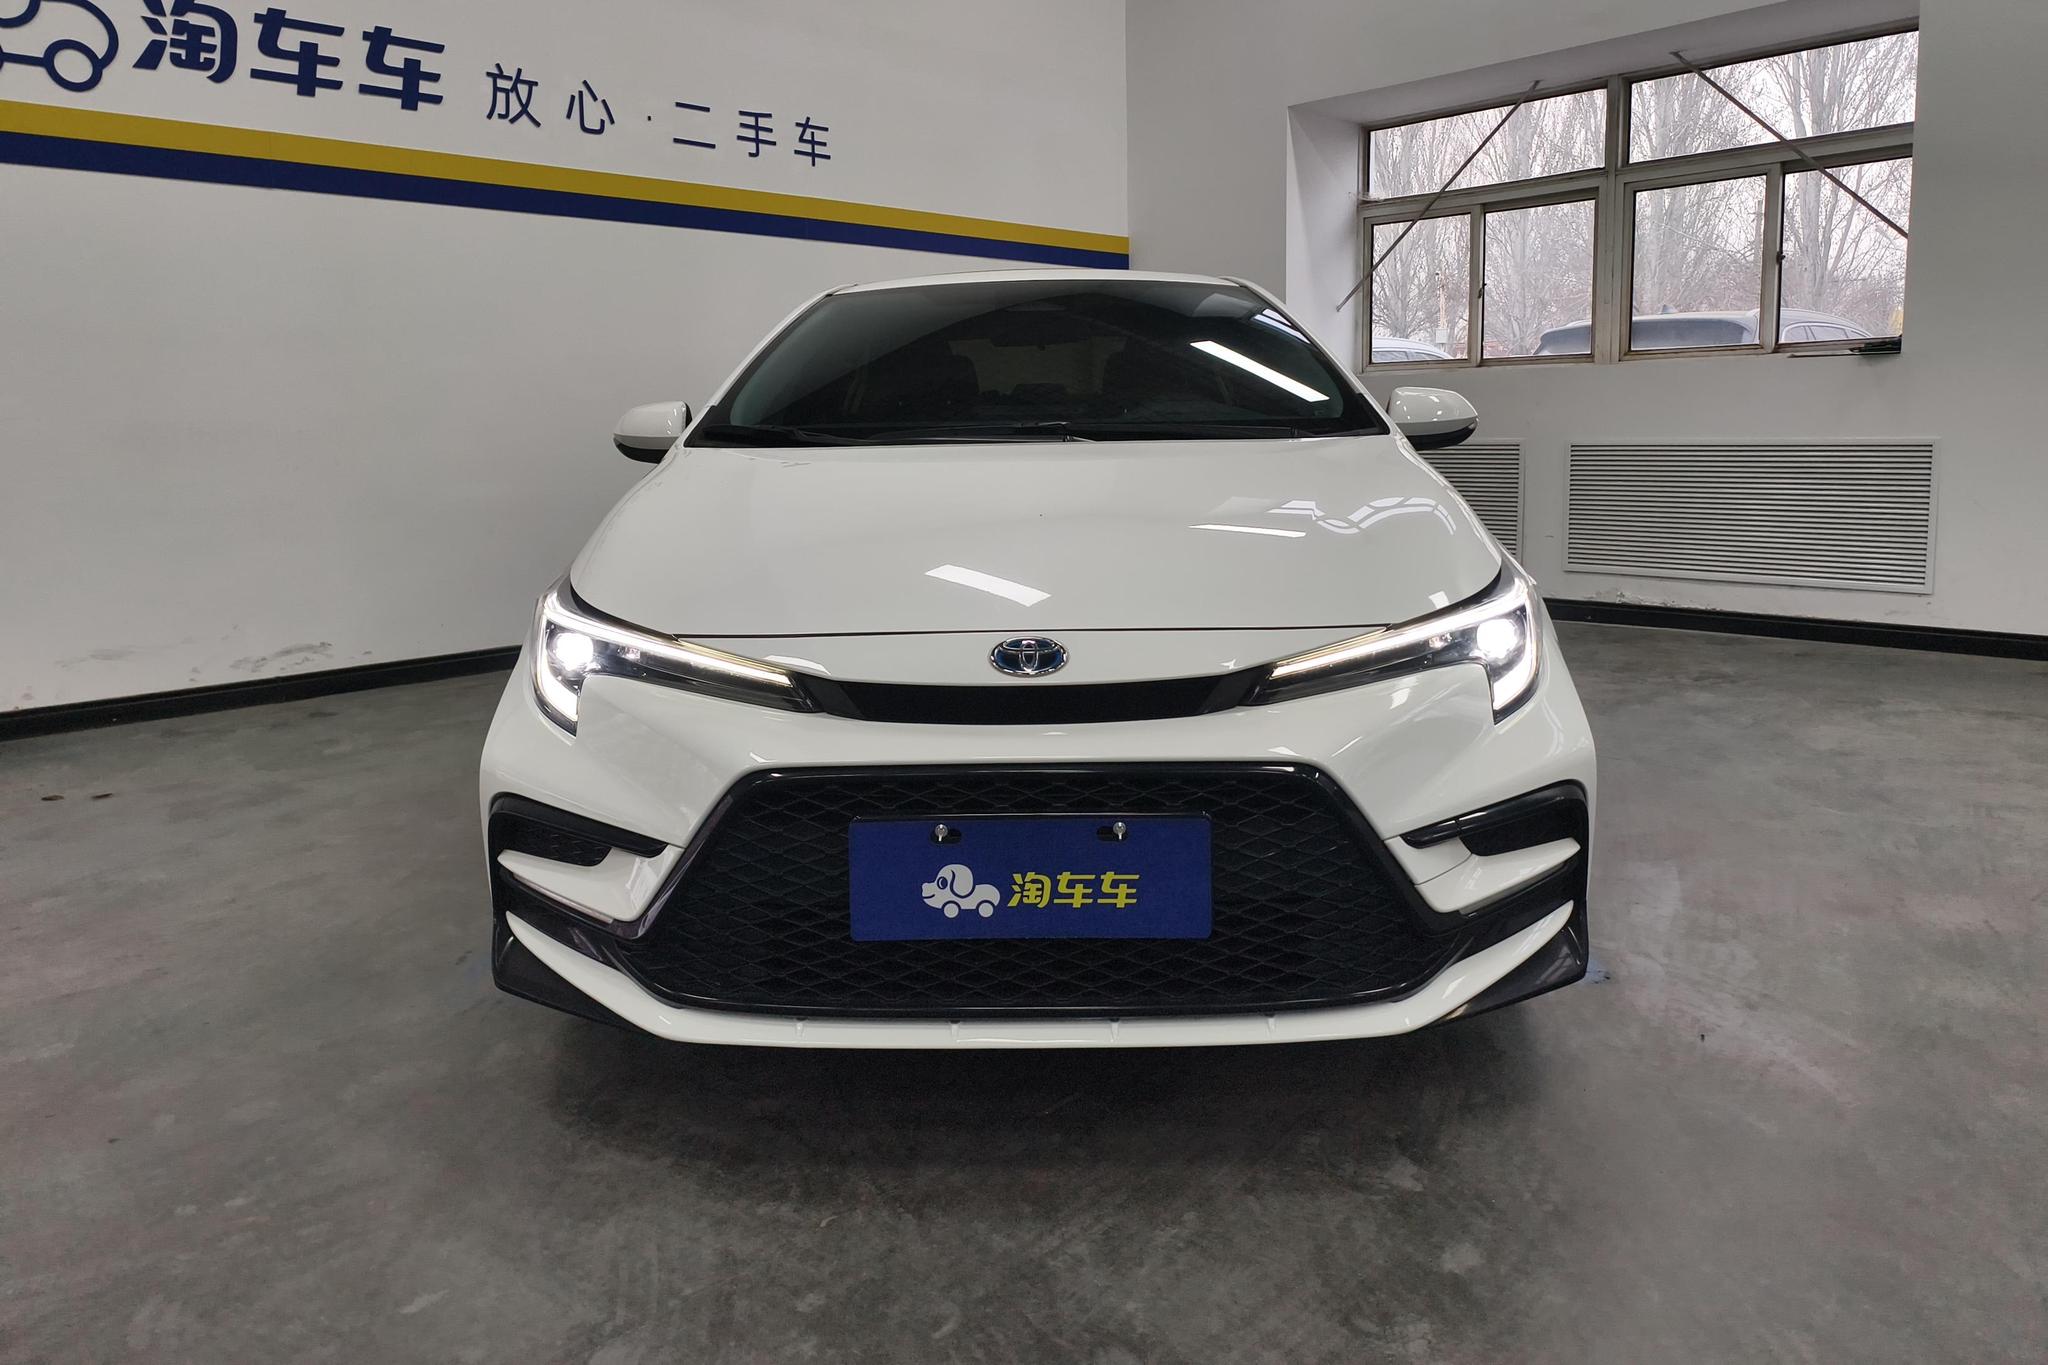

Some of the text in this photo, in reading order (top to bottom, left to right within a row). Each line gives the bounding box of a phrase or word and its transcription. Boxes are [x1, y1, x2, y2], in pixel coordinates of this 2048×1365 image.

[132, 0, 446, 112] 淘车车
[1007, 871, 1140, 909] 淘车车
